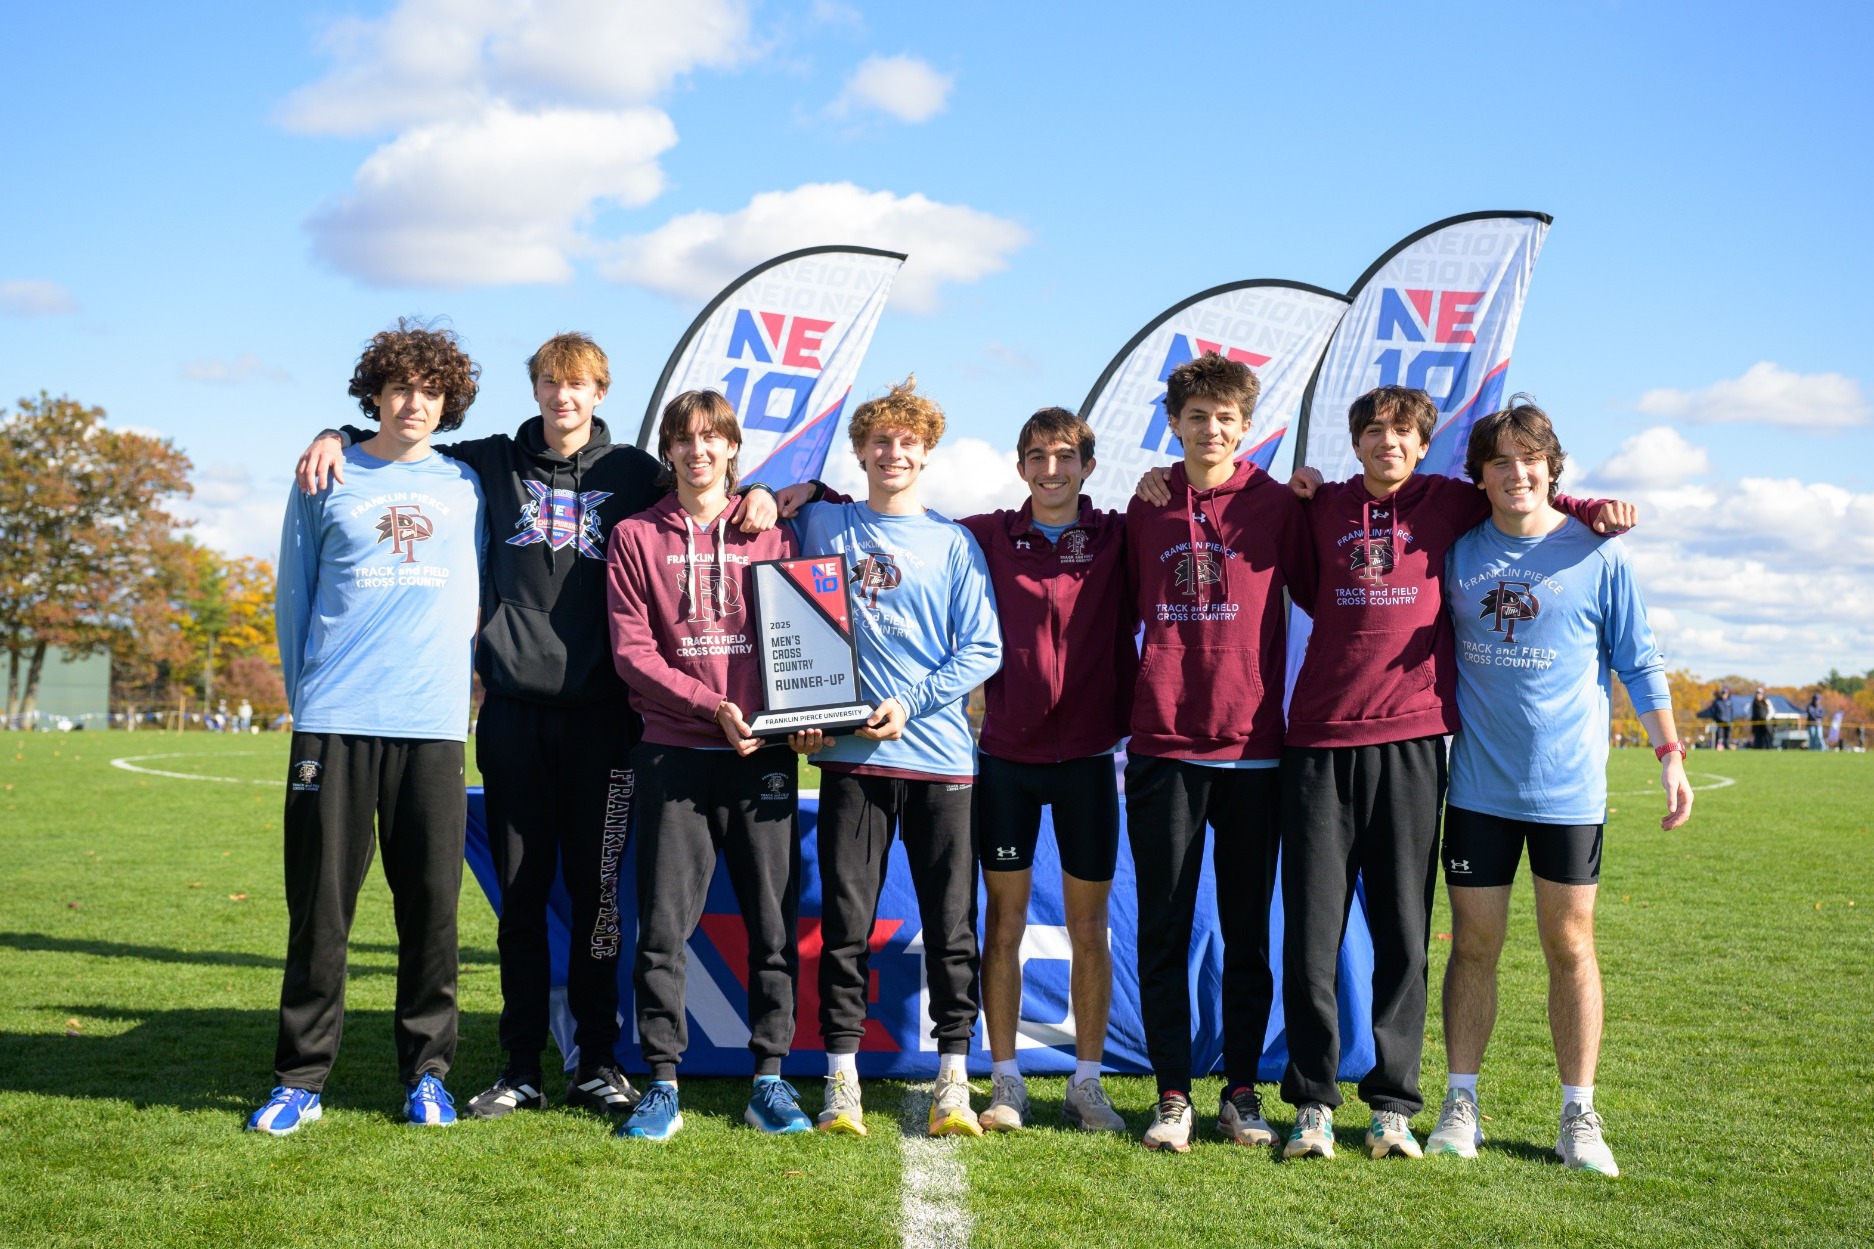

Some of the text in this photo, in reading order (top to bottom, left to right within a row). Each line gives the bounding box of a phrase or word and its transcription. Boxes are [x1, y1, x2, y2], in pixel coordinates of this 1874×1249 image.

[1377, 288, 1487, 344] NE
[727, 308, 836, 371] NE
[721, 367, 818, 433] 10
[350, 492, 450, 519] FRANKLIN PIERCE
[1384, 528, 1414, 544] PIRCE
[844, 540, 886, 552] RNKLIN
[1160, 542, 1203, 562] FRANKLN
[720, 553, 749, 564] IERCE
[354, 566, 450, 577] TRACK and FIELD
[811, 562, 838, 577] NE
[356, 577, 447, 588] CROSS COUNTRY
[814, 577, 839, 593] 10
[1464, 568, 1564, 595] FRANKLIN PIERCE
[1335, 586, 1418, 597] TRACK and FIELD
[1156, 603, 1239, 612] TRACK and FIELD
[1337, 596, 1416, 605] CROSS COUNTRY
[883, 613, 915, 628] FIELD
[1157, 613, 1237, 621] CROSS COUNTRY
[770, 621, 791, 630] 2025
[862, 620, 912, 638] CNTRY
[681, 635, 713, 646] TRACK
[721, 634, 746, 645] FIELD
[771, 635, 801, 648] MEN'S
[677, 644, 752, 656] CROSS COUNTRY
[772, 648, 801, 660] CROSS
[1463, 640, 1556, 660] TRACK and FIELD
[774, 659, 814, 673] COUNTRY
[1464, 652, 1552, 670] CROSS COUNTRY
[775, 673, 845, 692] RUNNER-UP
[765, 710, 862, 725] FRANKLIN PIERCE UNIVERSITY
[601, 768, 636, 886] FRANKLIN
